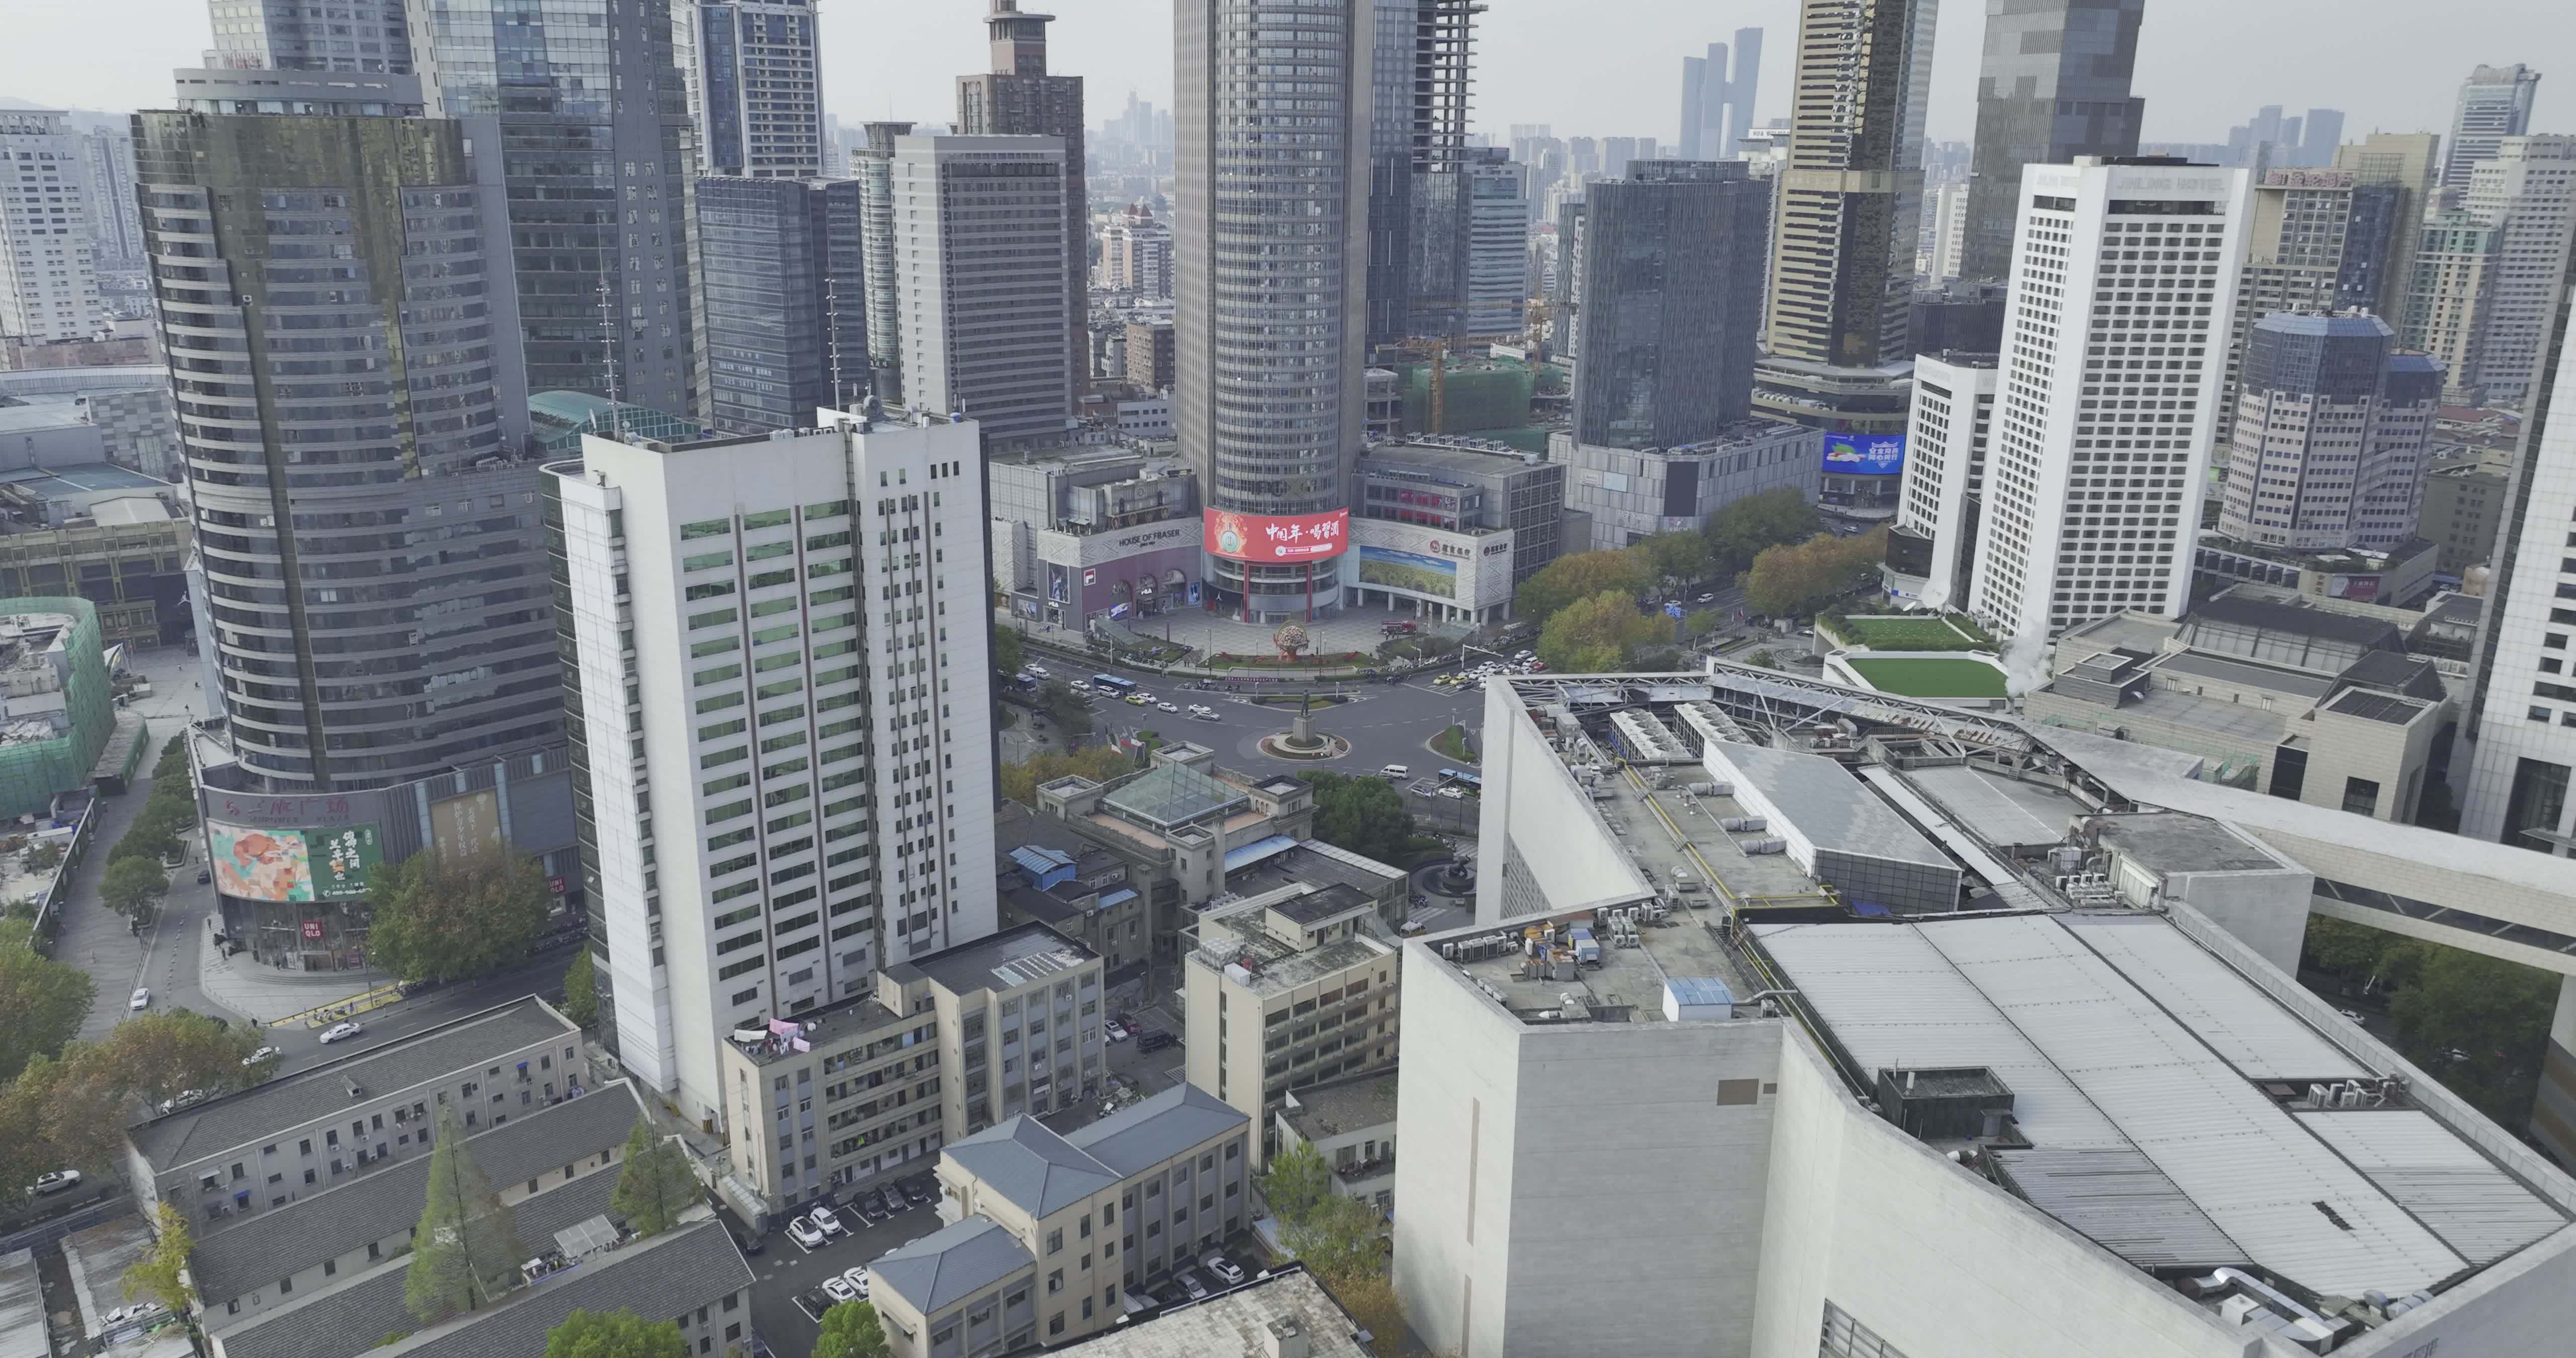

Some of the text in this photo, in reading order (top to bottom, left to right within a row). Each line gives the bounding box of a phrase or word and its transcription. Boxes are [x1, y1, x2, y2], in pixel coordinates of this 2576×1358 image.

[1119, 529, 1180, 547] HOUSE OF FRASER
